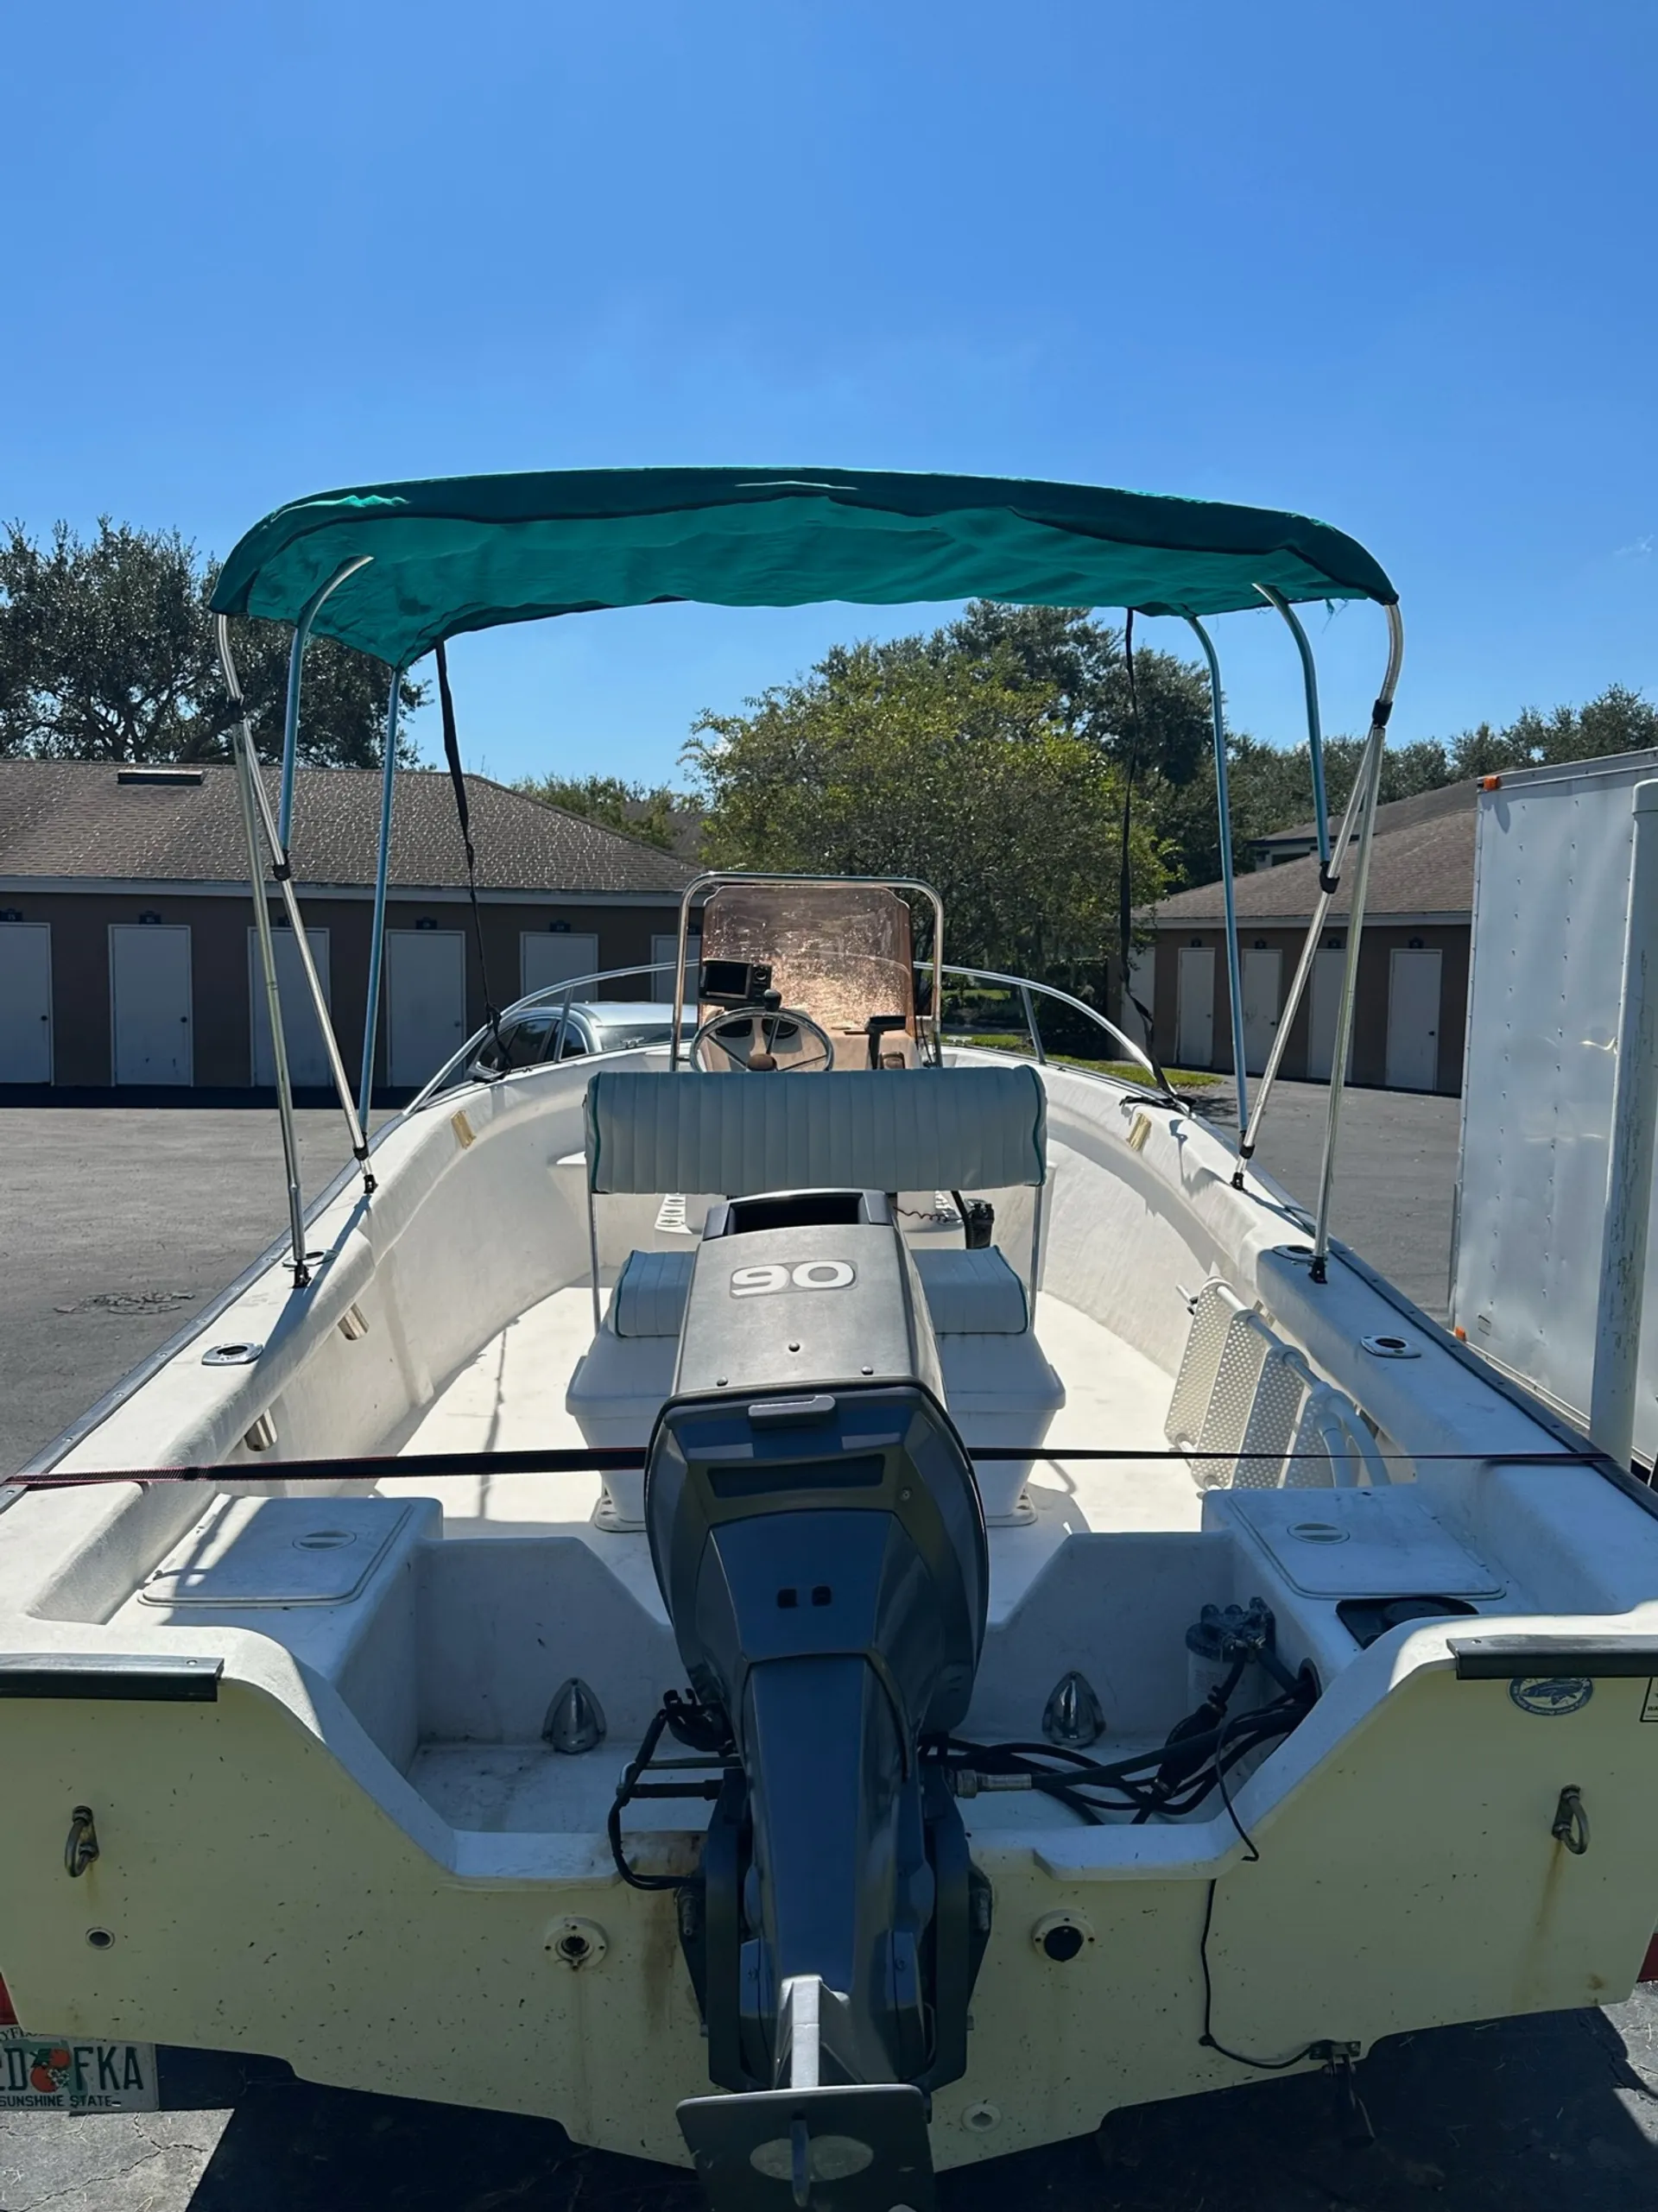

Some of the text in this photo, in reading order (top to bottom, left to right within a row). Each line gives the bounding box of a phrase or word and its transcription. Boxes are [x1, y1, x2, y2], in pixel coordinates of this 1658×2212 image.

[731, 1261, 854, 1296] 90
[0, 2046, 144, 2090] D FKA
[0, 2095, 112, 2108] SUNSHINE STATE
